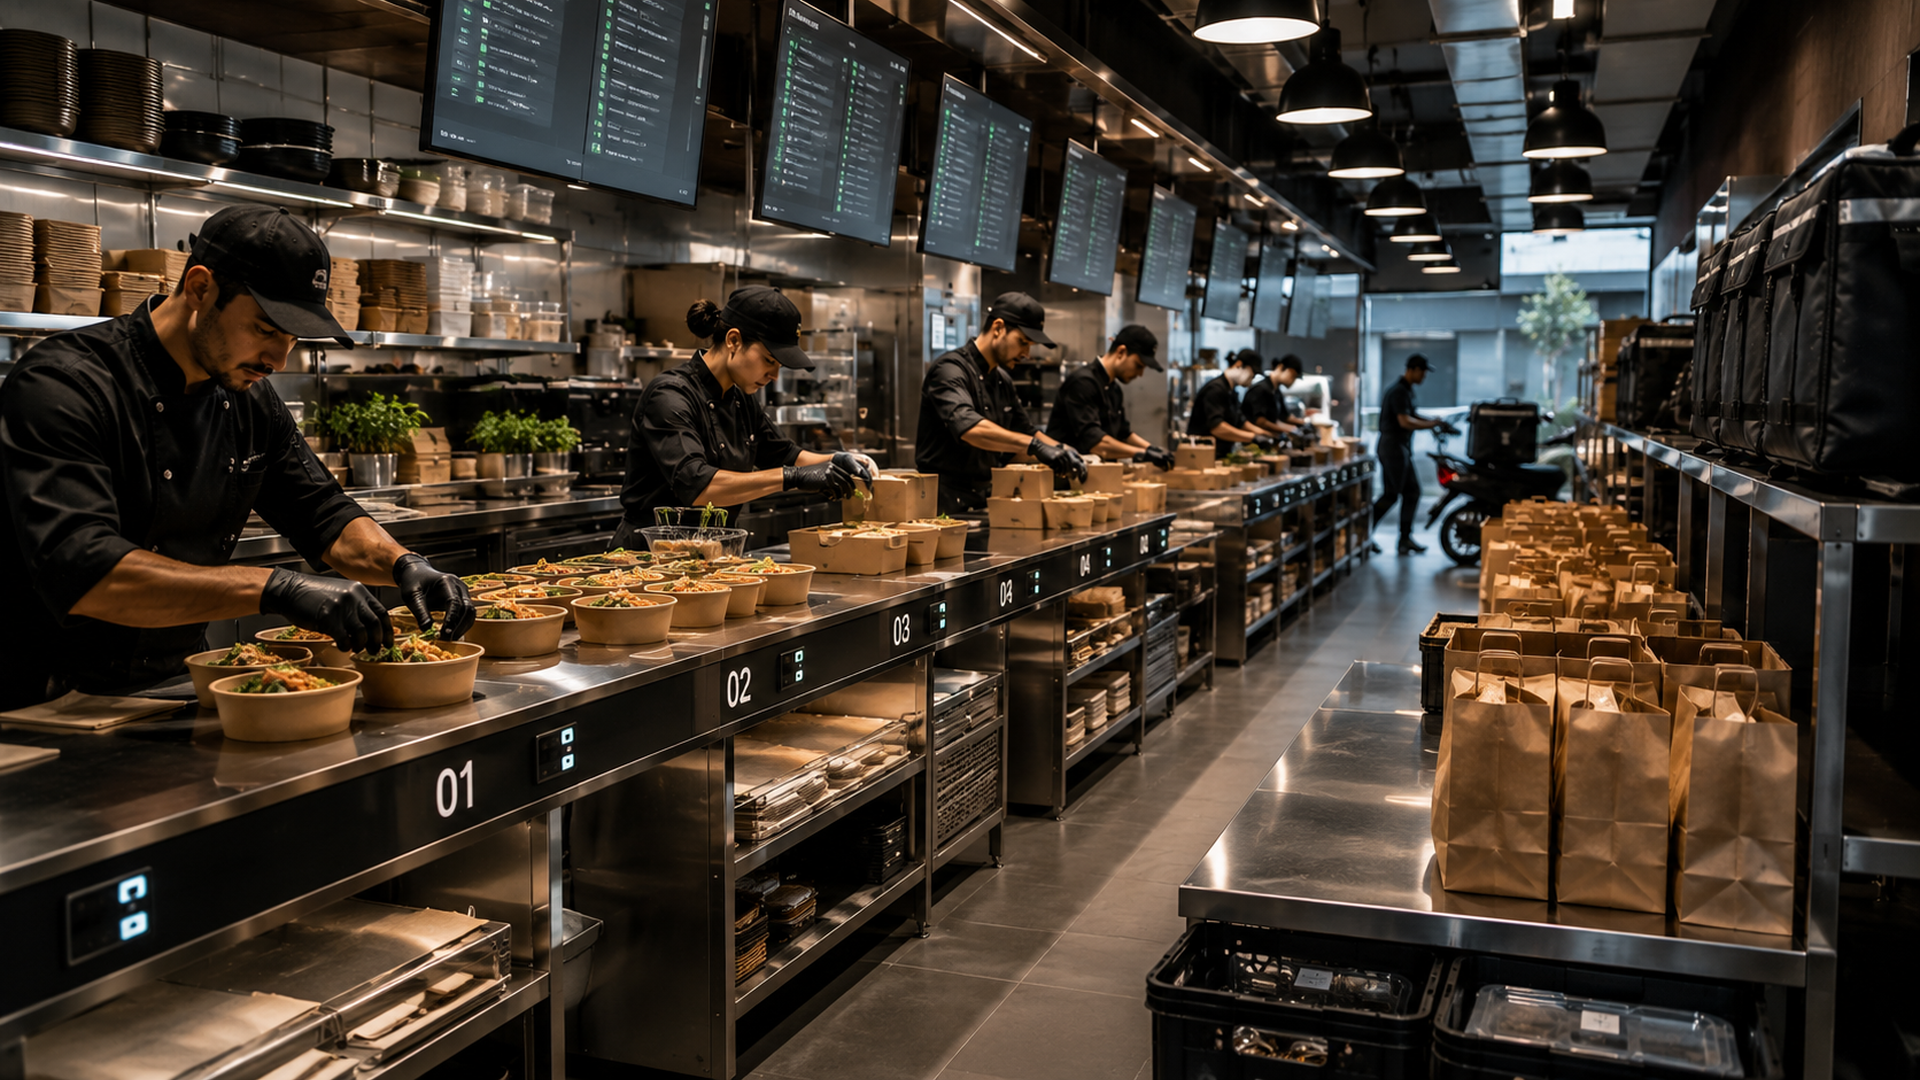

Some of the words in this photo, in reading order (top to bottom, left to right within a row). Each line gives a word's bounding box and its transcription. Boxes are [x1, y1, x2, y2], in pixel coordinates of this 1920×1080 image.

[893, 613, 910, 646] 03
[727, 666, 751, 708] 02
[436, 759, 473, 818] 01
